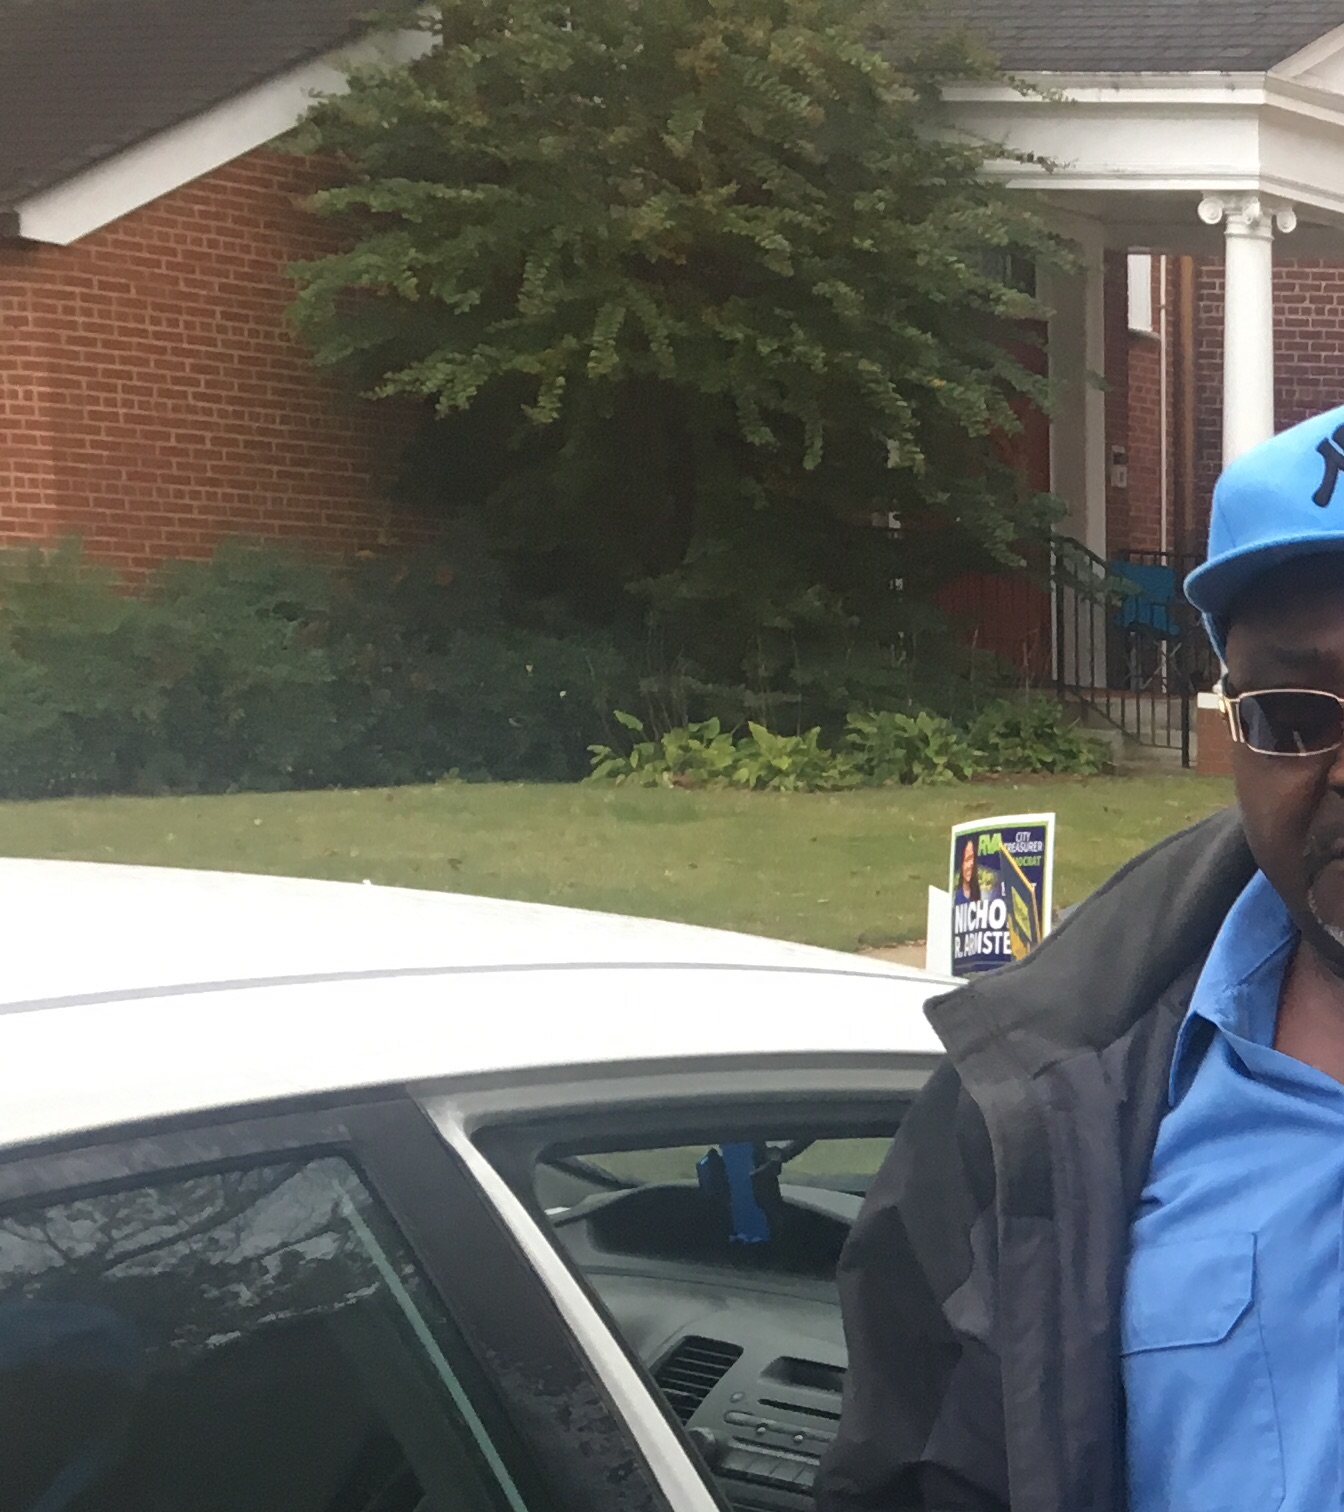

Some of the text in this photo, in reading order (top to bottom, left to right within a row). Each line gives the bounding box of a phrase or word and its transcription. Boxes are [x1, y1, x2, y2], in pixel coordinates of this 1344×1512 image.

[978, 833, 1002, 856] RVA
[1015, 831, 1032, 842] CITY
[954, 898, 1008, 934] NICHO
